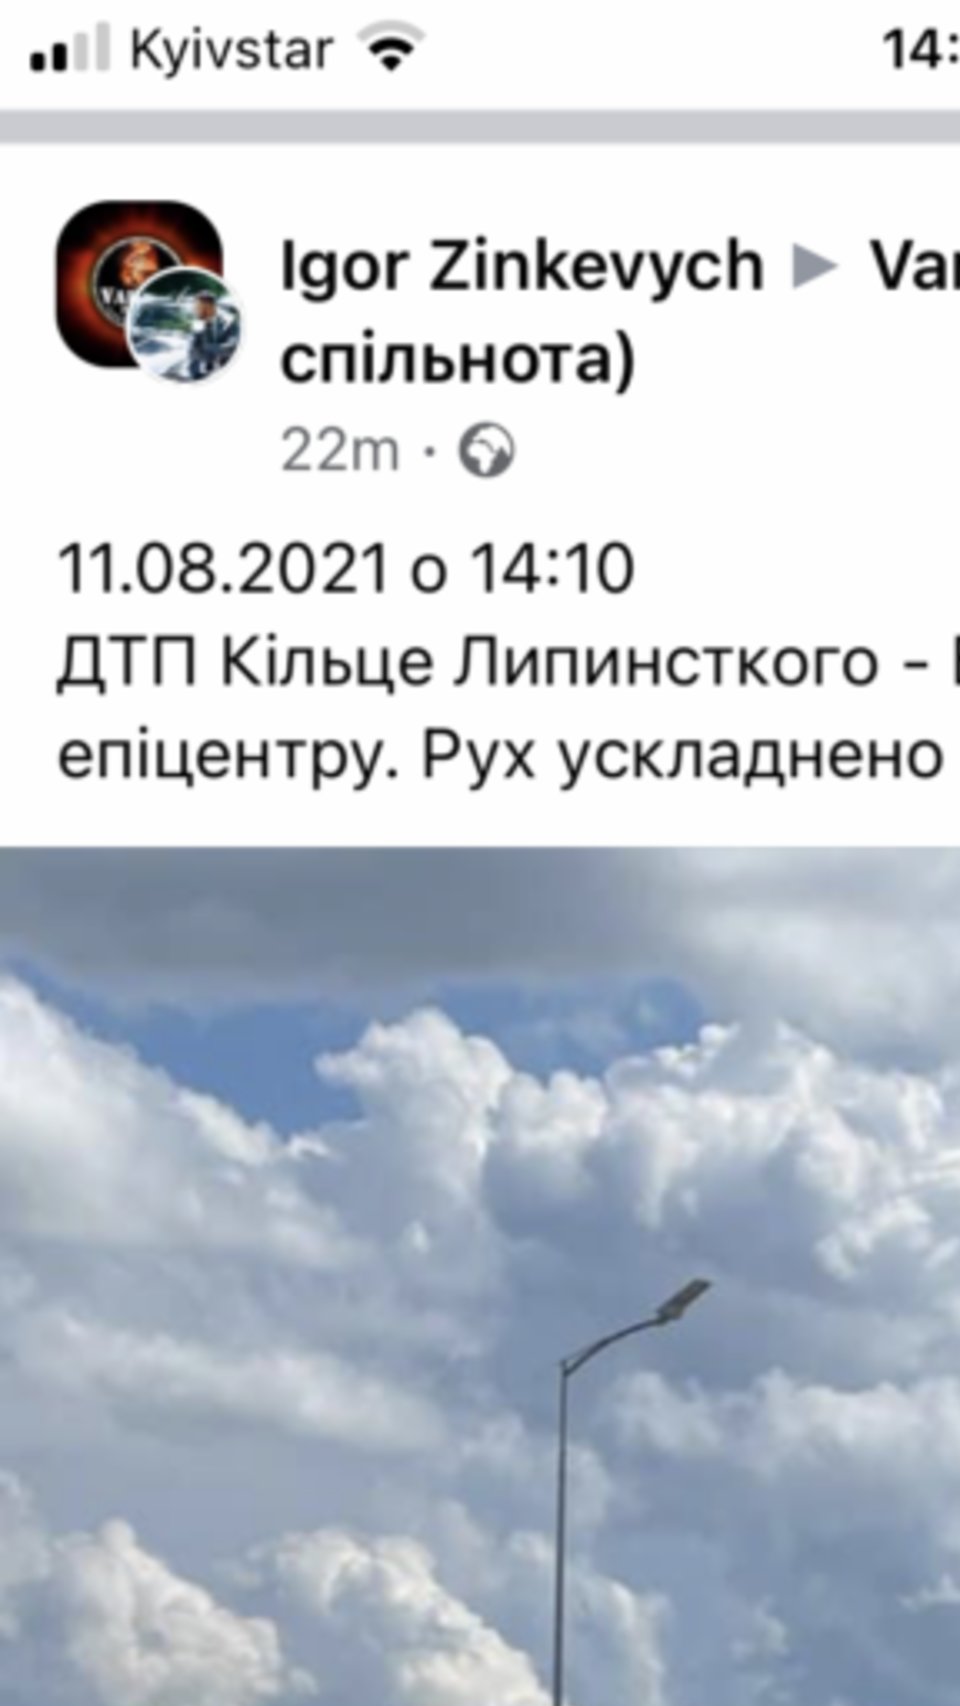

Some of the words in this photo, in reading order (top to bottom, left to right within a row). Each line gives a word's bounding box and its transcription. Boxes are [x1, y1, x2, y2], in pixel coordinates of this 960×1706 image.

[131, 25, 335, 81] Kyivstar
[282, 238, 411, 305] Igor
[429, 234, 764, 304] Zinkevych
[280, 327, 635, 396] спільнота)
[281, 424, 400, 472] 22m
[58, 540, 385, 595] 11.08.2021
[410, 552, 448, 595] о
[471, 540, 635, 595] 14:10
[55, 633, 196, 697] ДТП
[222, 631, 435, 696] Кільце
[452, 633, 879, 688] Липинсткого
[58, 724, 398, 792] епіцентру.
[423, 726, 536, 792] Рух
[556, 738, 945, 792] ускладнено
